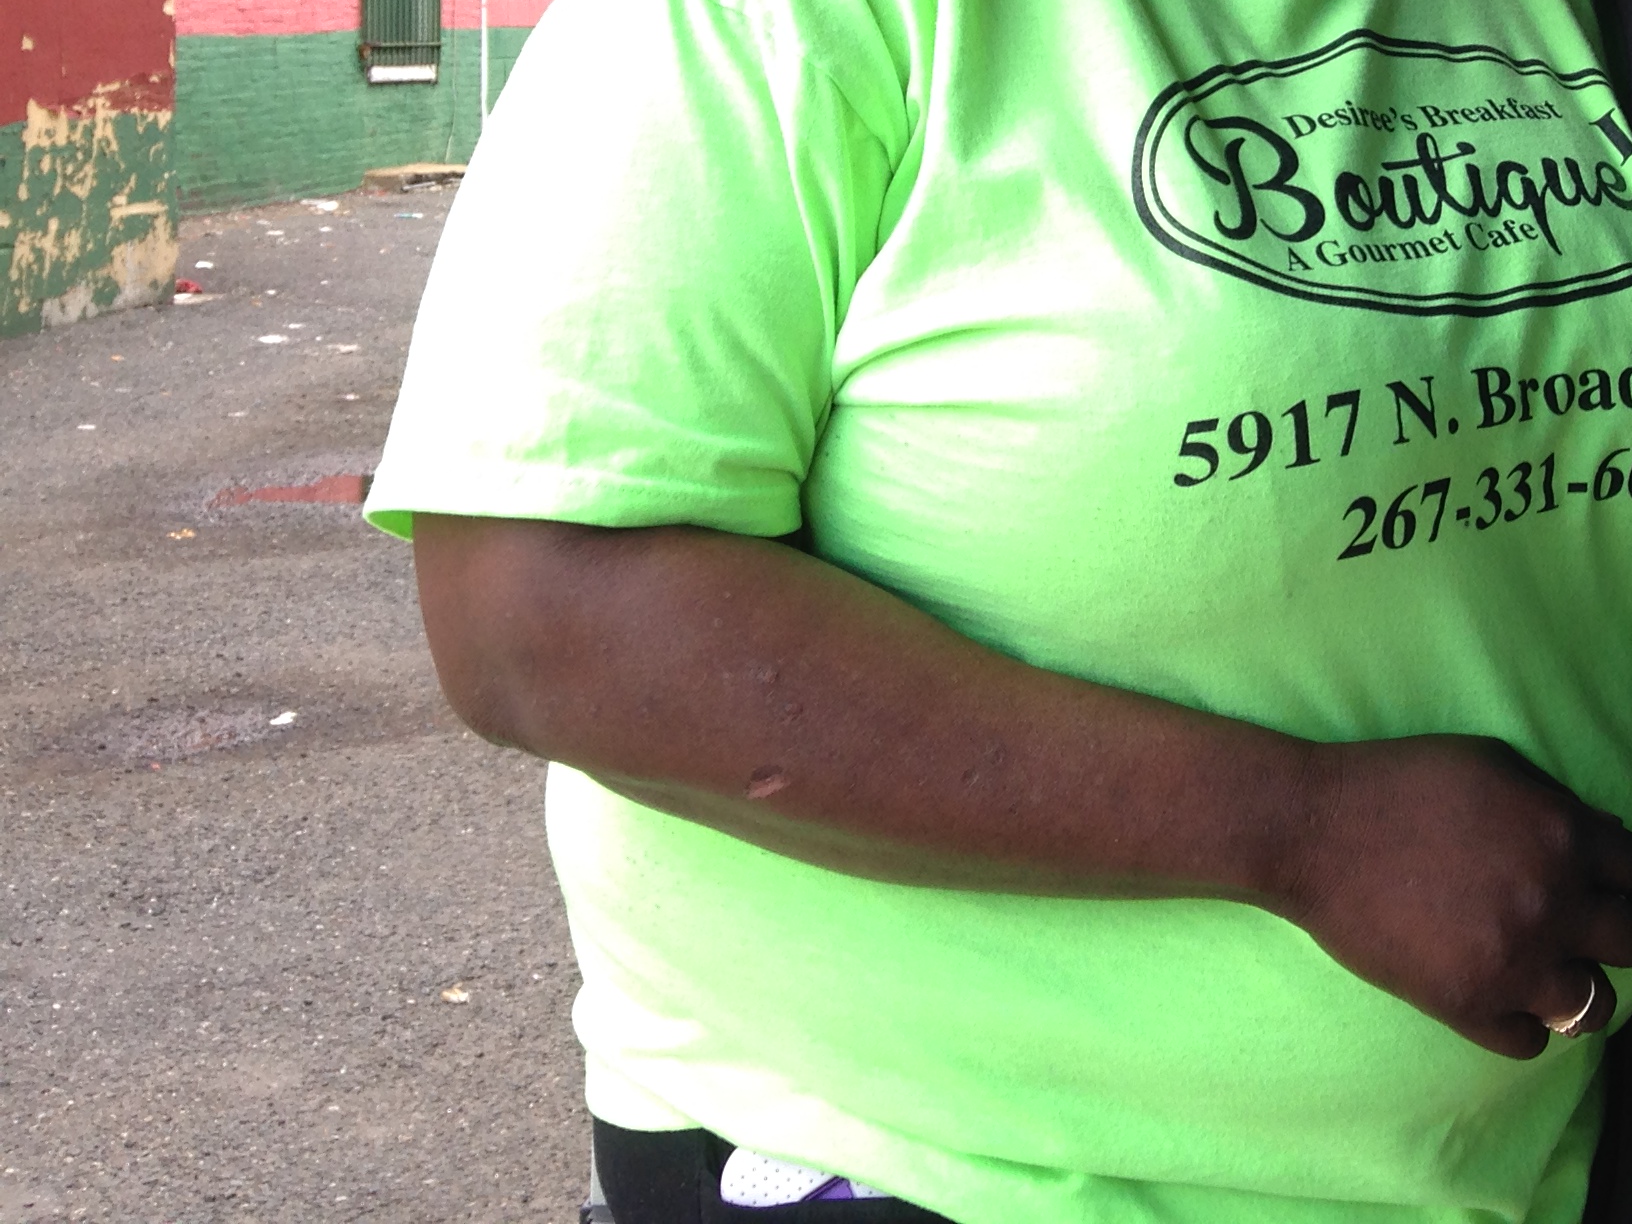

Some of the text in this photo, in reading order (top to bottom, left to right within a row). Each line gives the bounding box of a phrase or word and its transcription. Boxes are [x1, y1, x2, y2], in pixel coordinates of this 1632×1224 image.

[1282, 97, 1563, 139] Desiree's Breakfast
[1287, 218, 1540, 272] A Gourmet Cafe
[1172, 387, 1362, 487] 5917
[1385, 374, 1460, 445] N.
